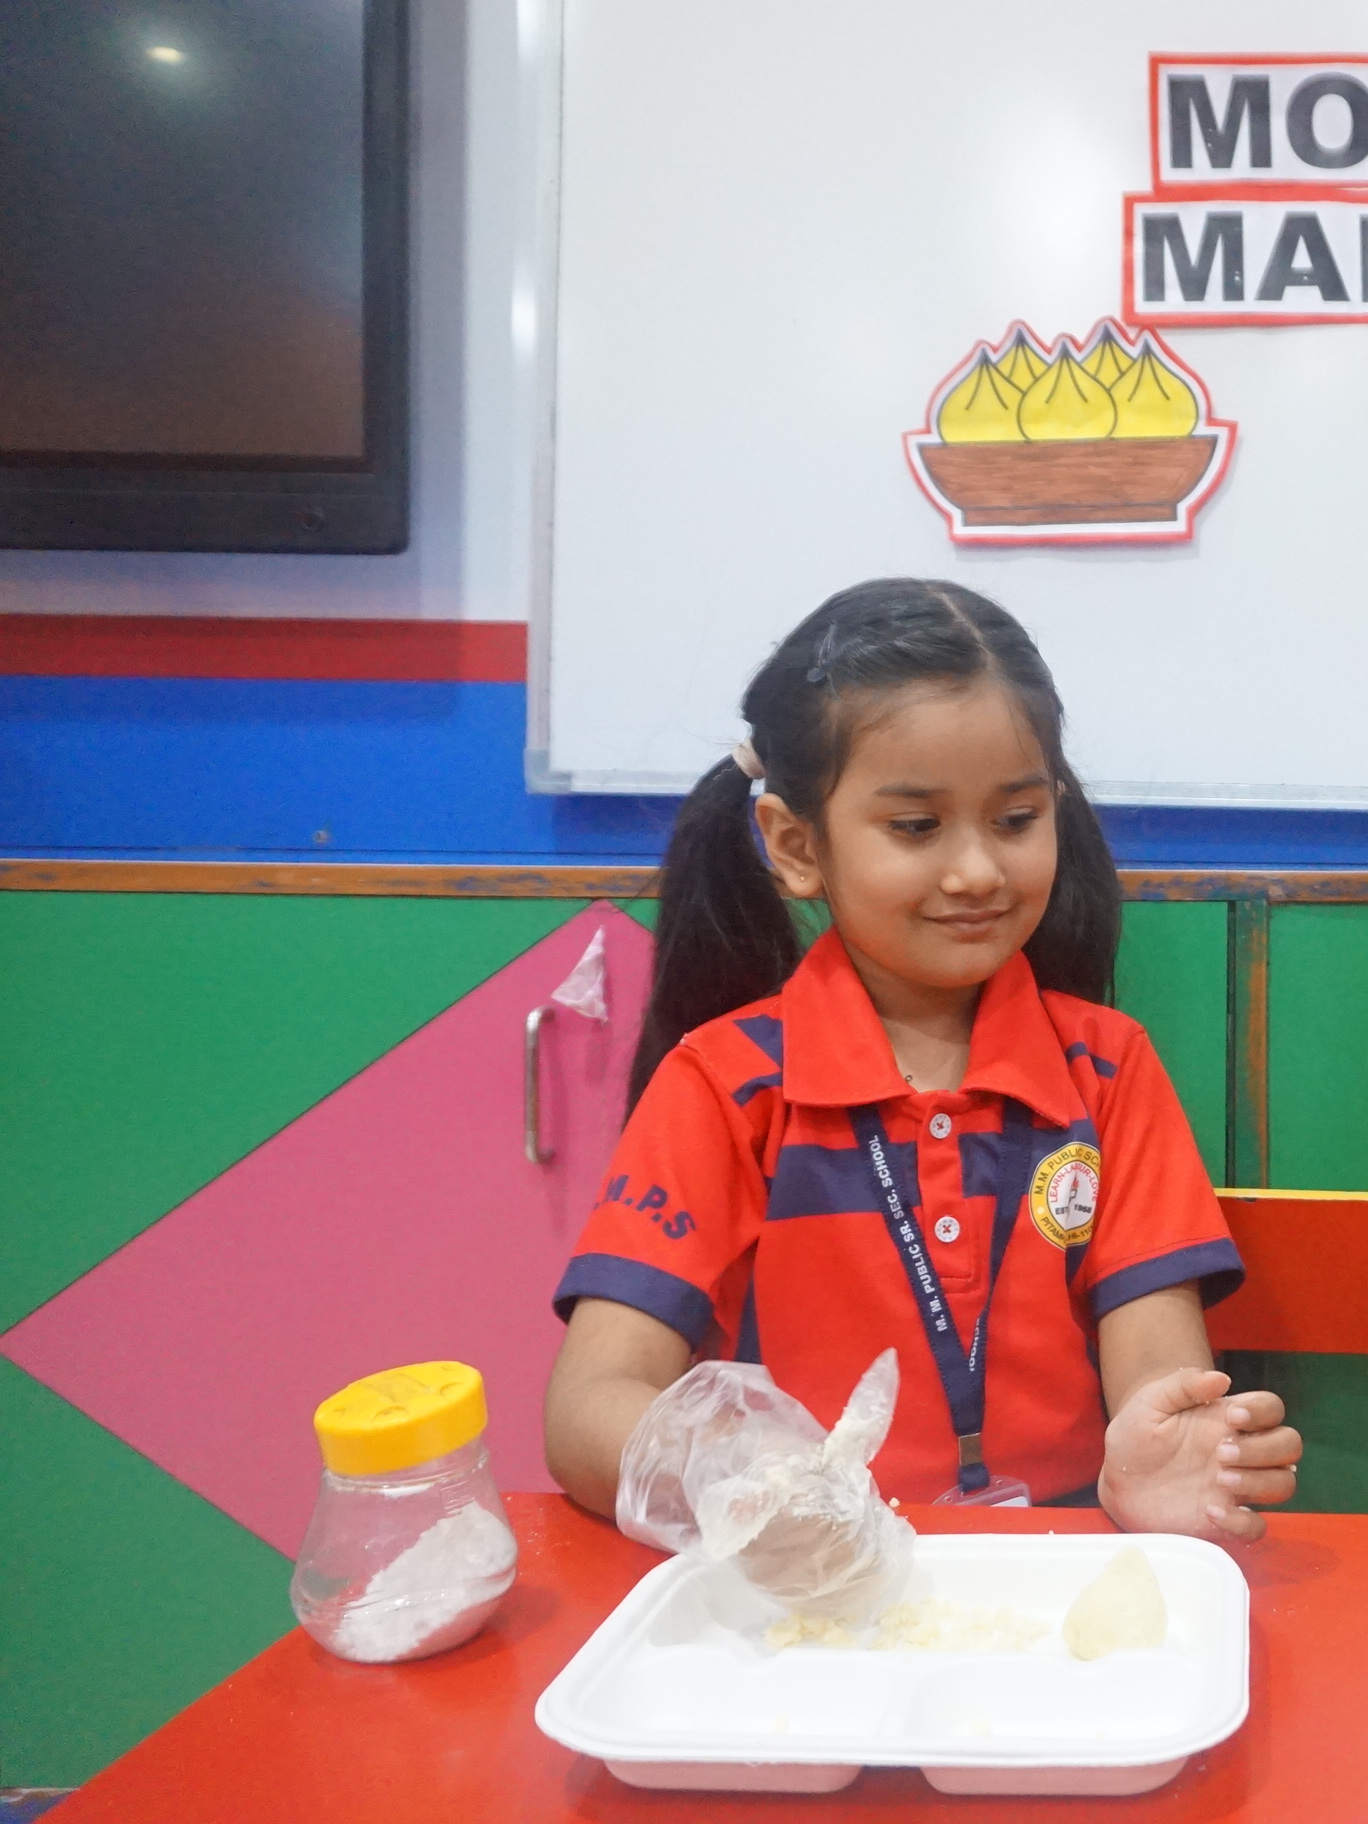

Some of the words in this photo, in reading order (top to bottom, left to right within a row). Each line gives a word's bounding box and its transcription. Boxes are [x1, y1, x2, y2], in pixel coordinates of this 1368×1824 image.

[868, 1134, 894, 1188] SCHOOL
[887, 1188, 905, 1220] SEC.
[900, 1220, 918, 1243] SR.
[908, 1243, 936, 1294] PUBLIC
